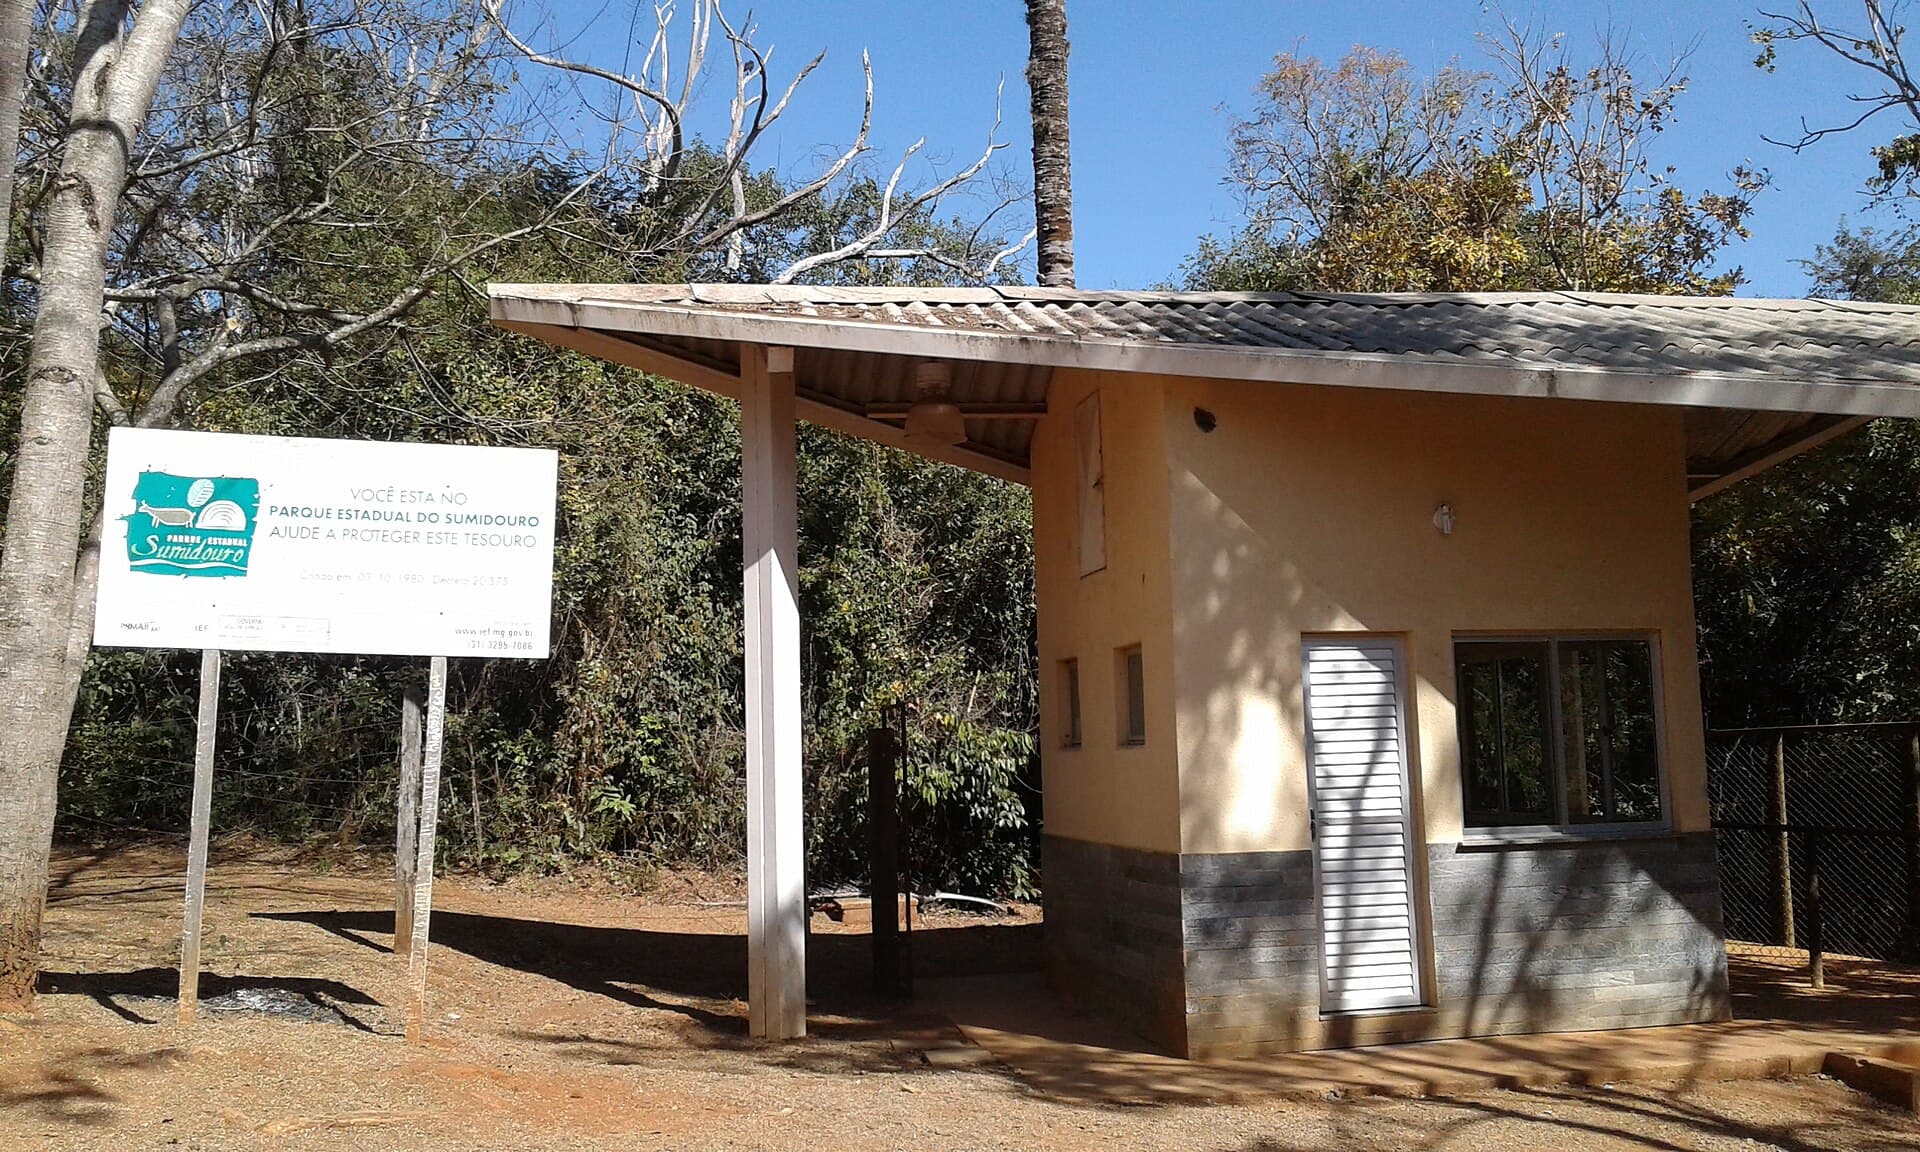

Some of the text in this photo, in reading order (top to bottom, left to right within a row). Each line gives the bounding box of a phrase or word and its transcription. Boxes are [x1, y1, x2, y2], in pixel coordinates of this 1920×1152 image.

[350, 486, 394, 503] VOCÊ
[441, 492, 468, 506] NO
[269, 505, 540, 528] PARQUE ESTADUAL DO SUMIDOURO
[131, 534, 244, 562] Sumidouro
[166, 534, 248, 547] PARQUE ESTADUAL
[269, 526, 537, 548] AJUDE A PROTEGER ESTE TESOURO
